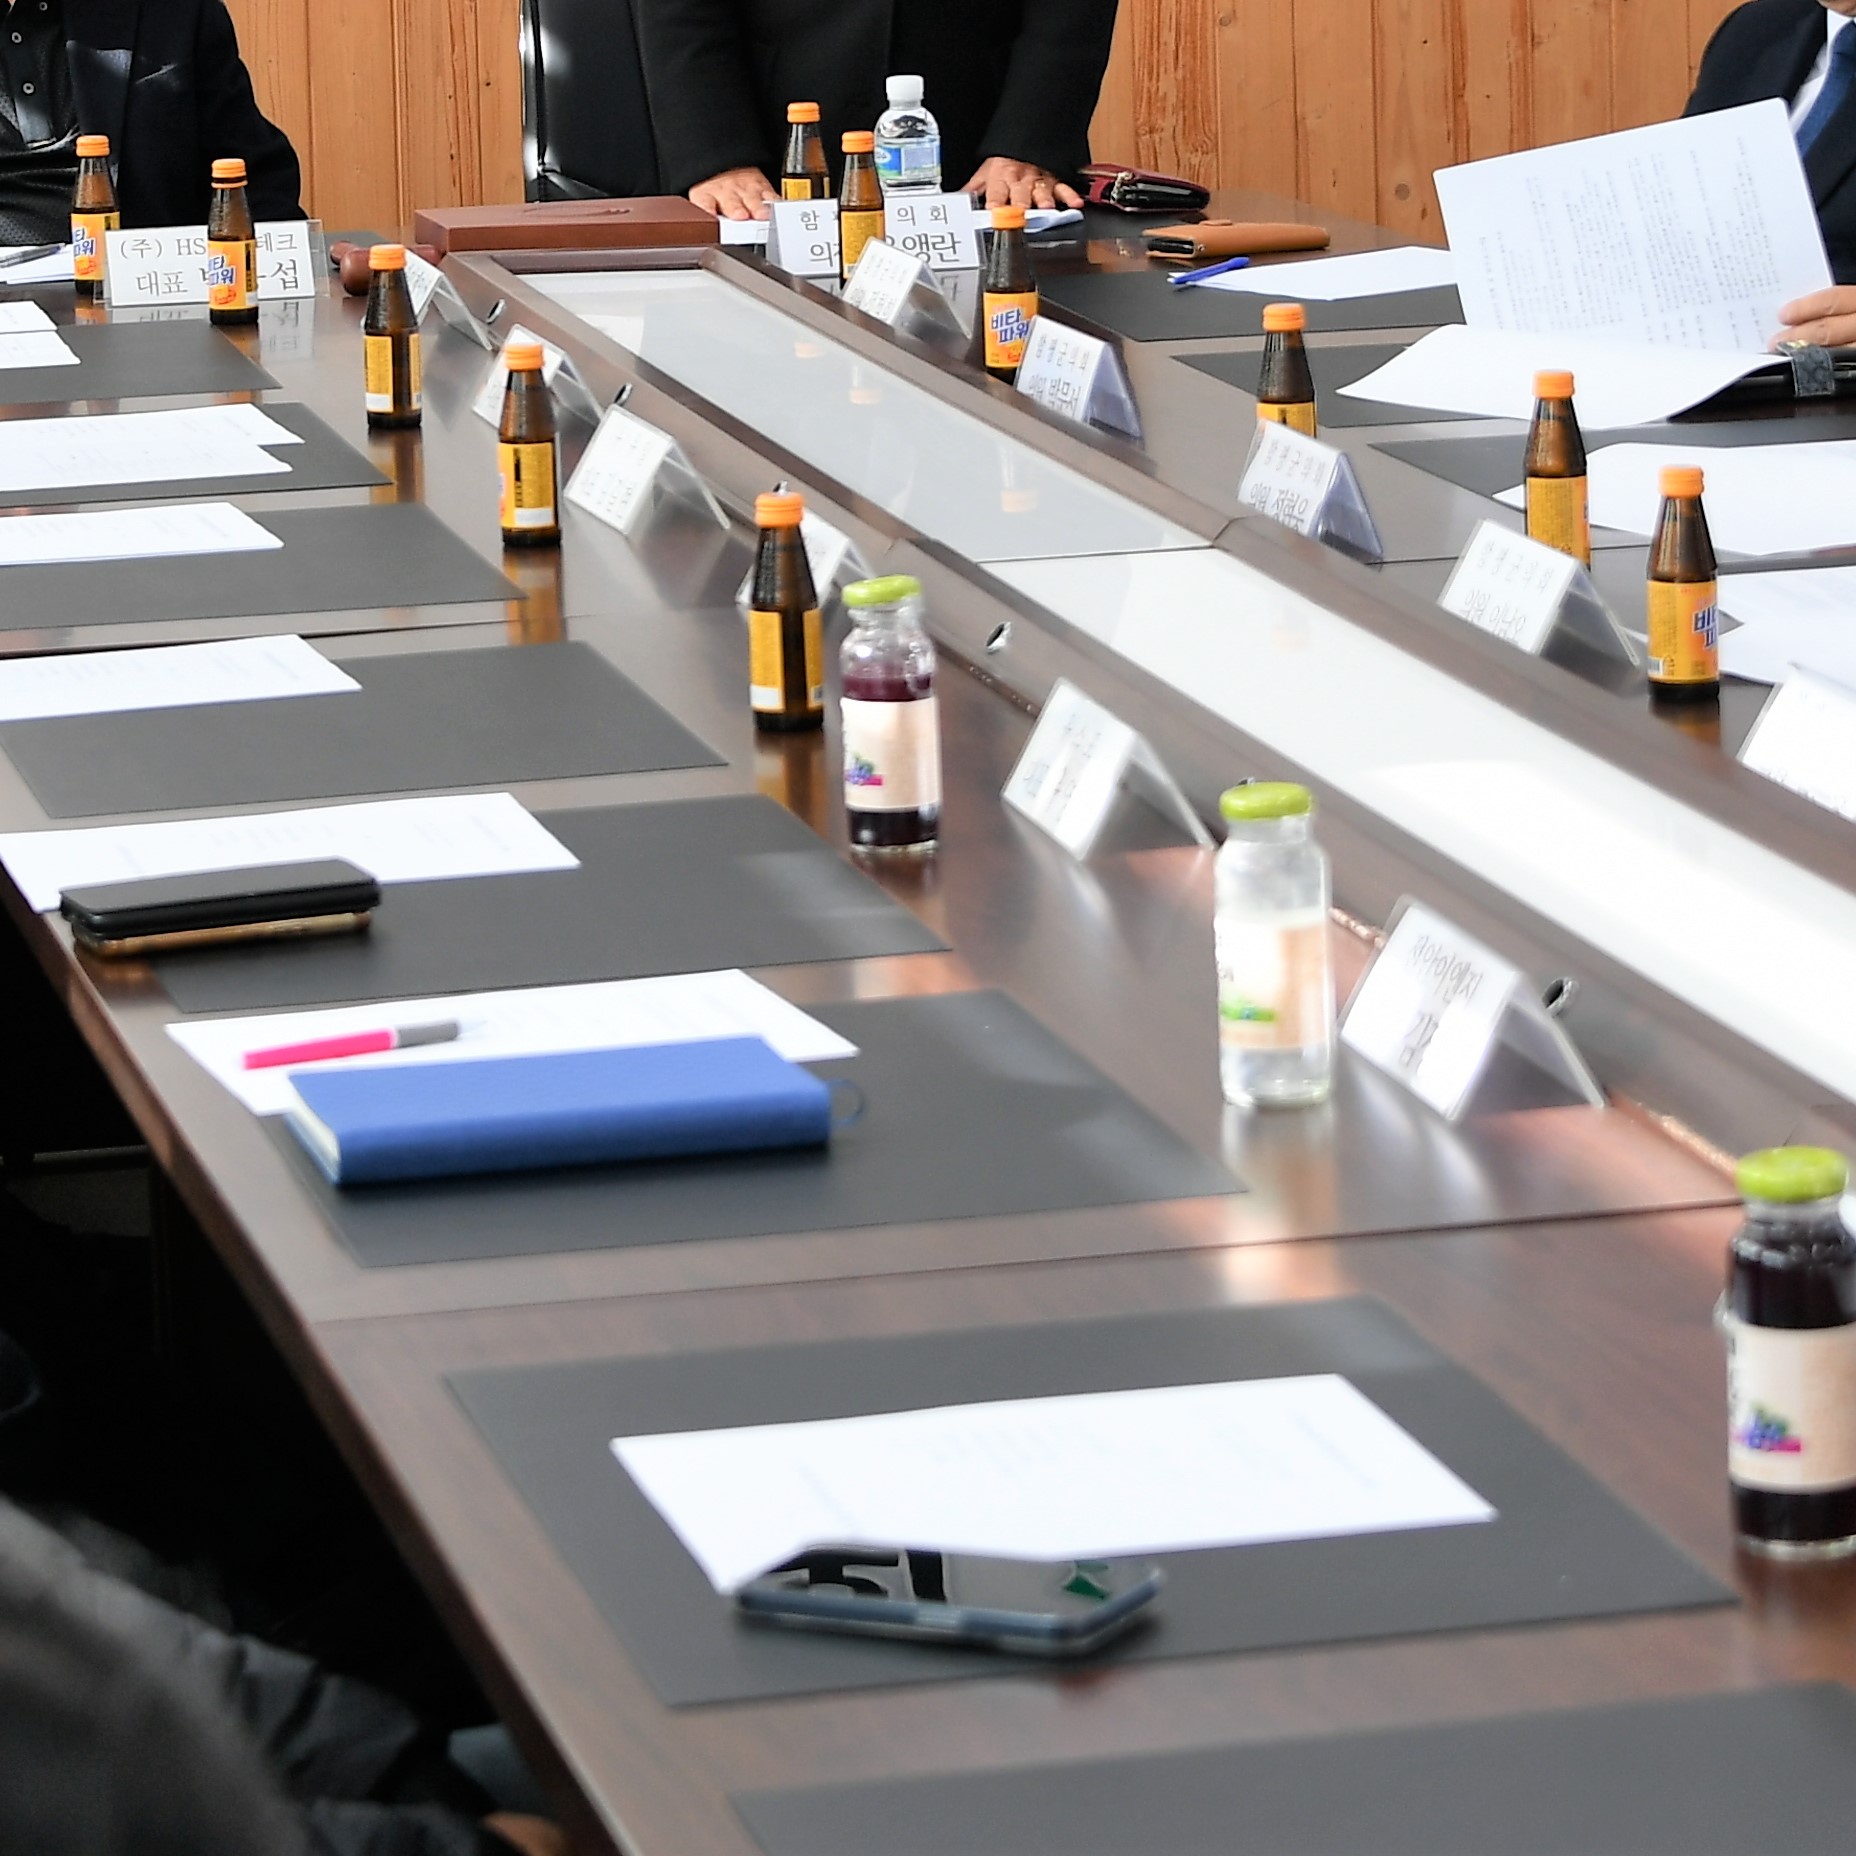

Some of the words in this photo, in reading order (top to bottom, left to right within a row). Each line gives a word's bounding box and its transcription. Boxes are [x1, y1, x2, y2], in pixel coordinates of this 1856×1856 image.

[120, 238, 162, 259] (주)
[809, 241, 841, 267] 의
[886, 232, 962, 263] 앵란
[137, 270, 188, 296] 대표
[992, 308, 1021, 330] 비타
